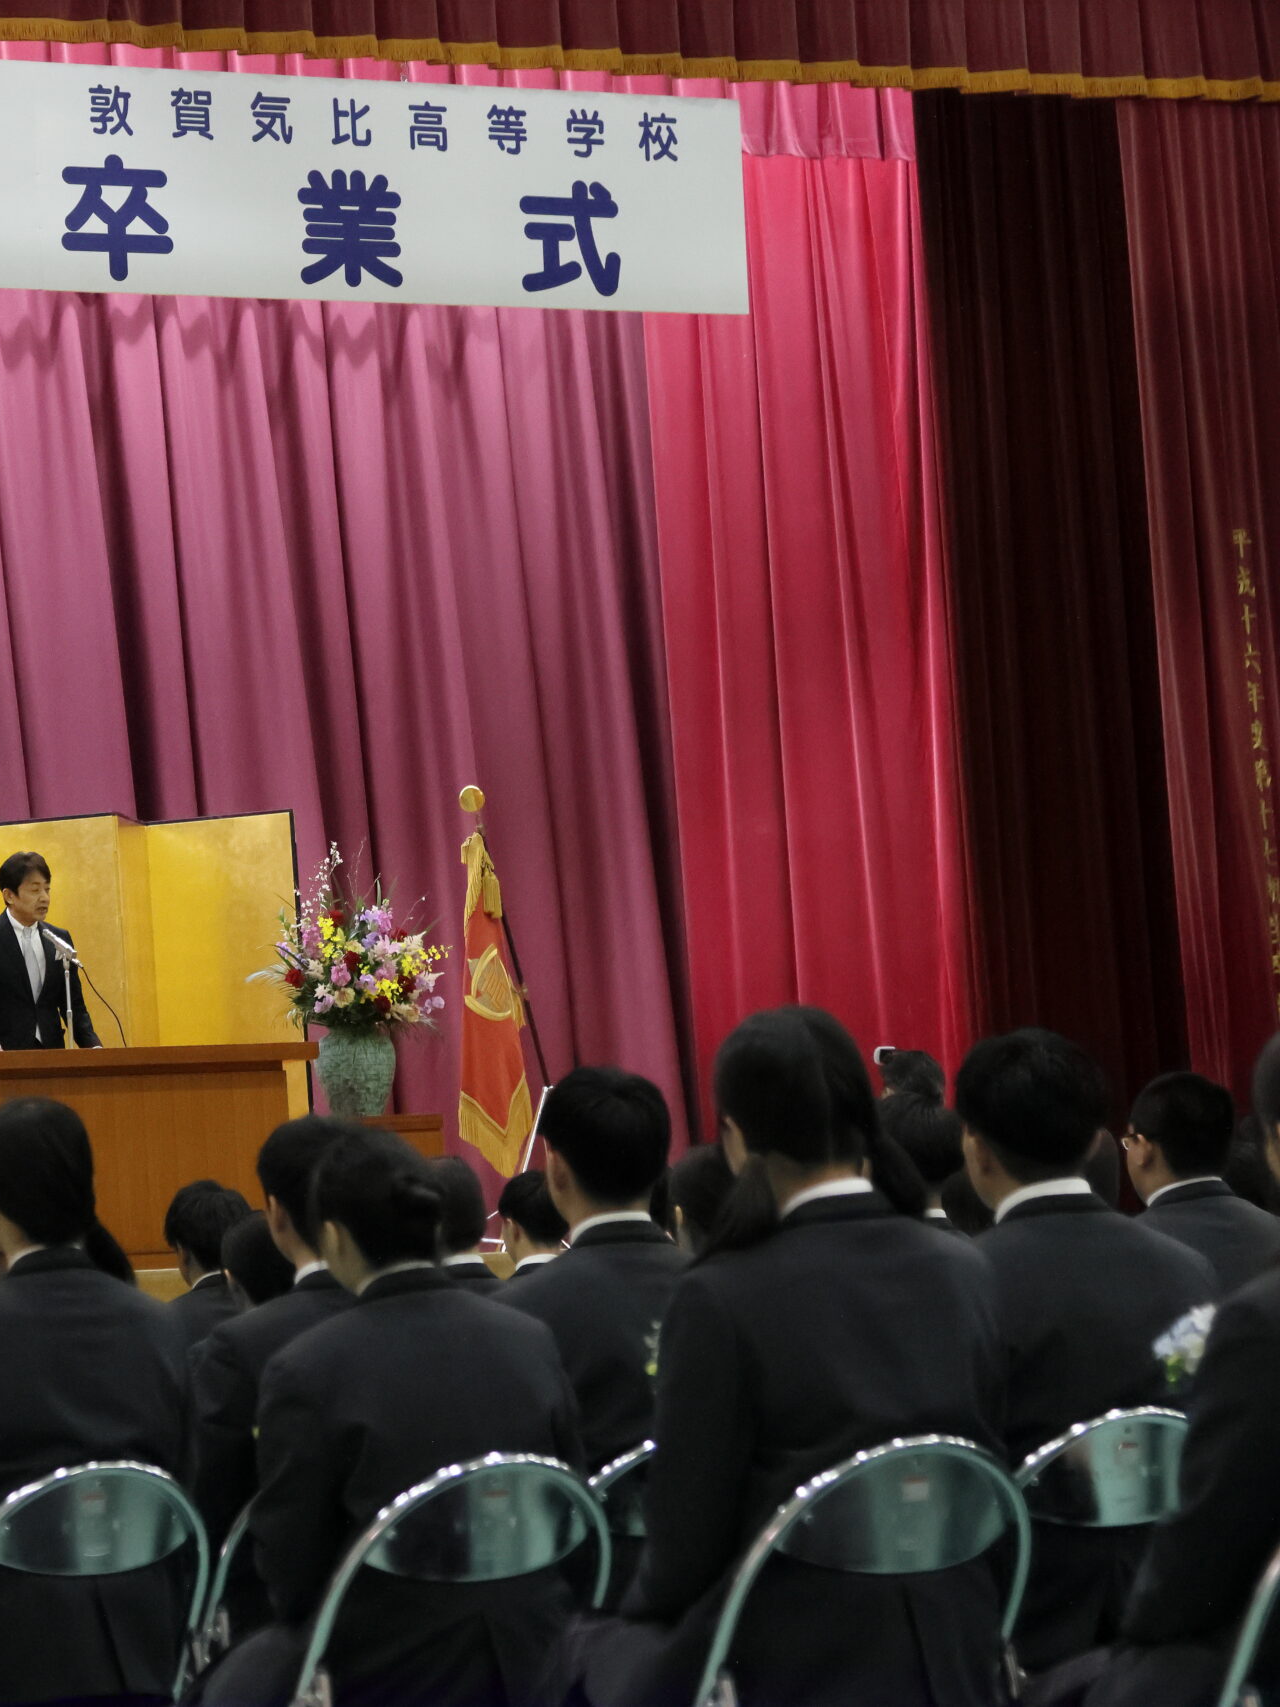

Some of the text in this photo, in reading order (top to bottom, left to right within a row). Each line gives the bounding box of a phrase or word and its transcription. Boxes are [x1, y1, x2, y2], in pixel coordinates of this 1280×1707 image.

[88, 84, 678, 162] 敦賀気比高等学校
[61, 154, 621, 297] 卒業式
